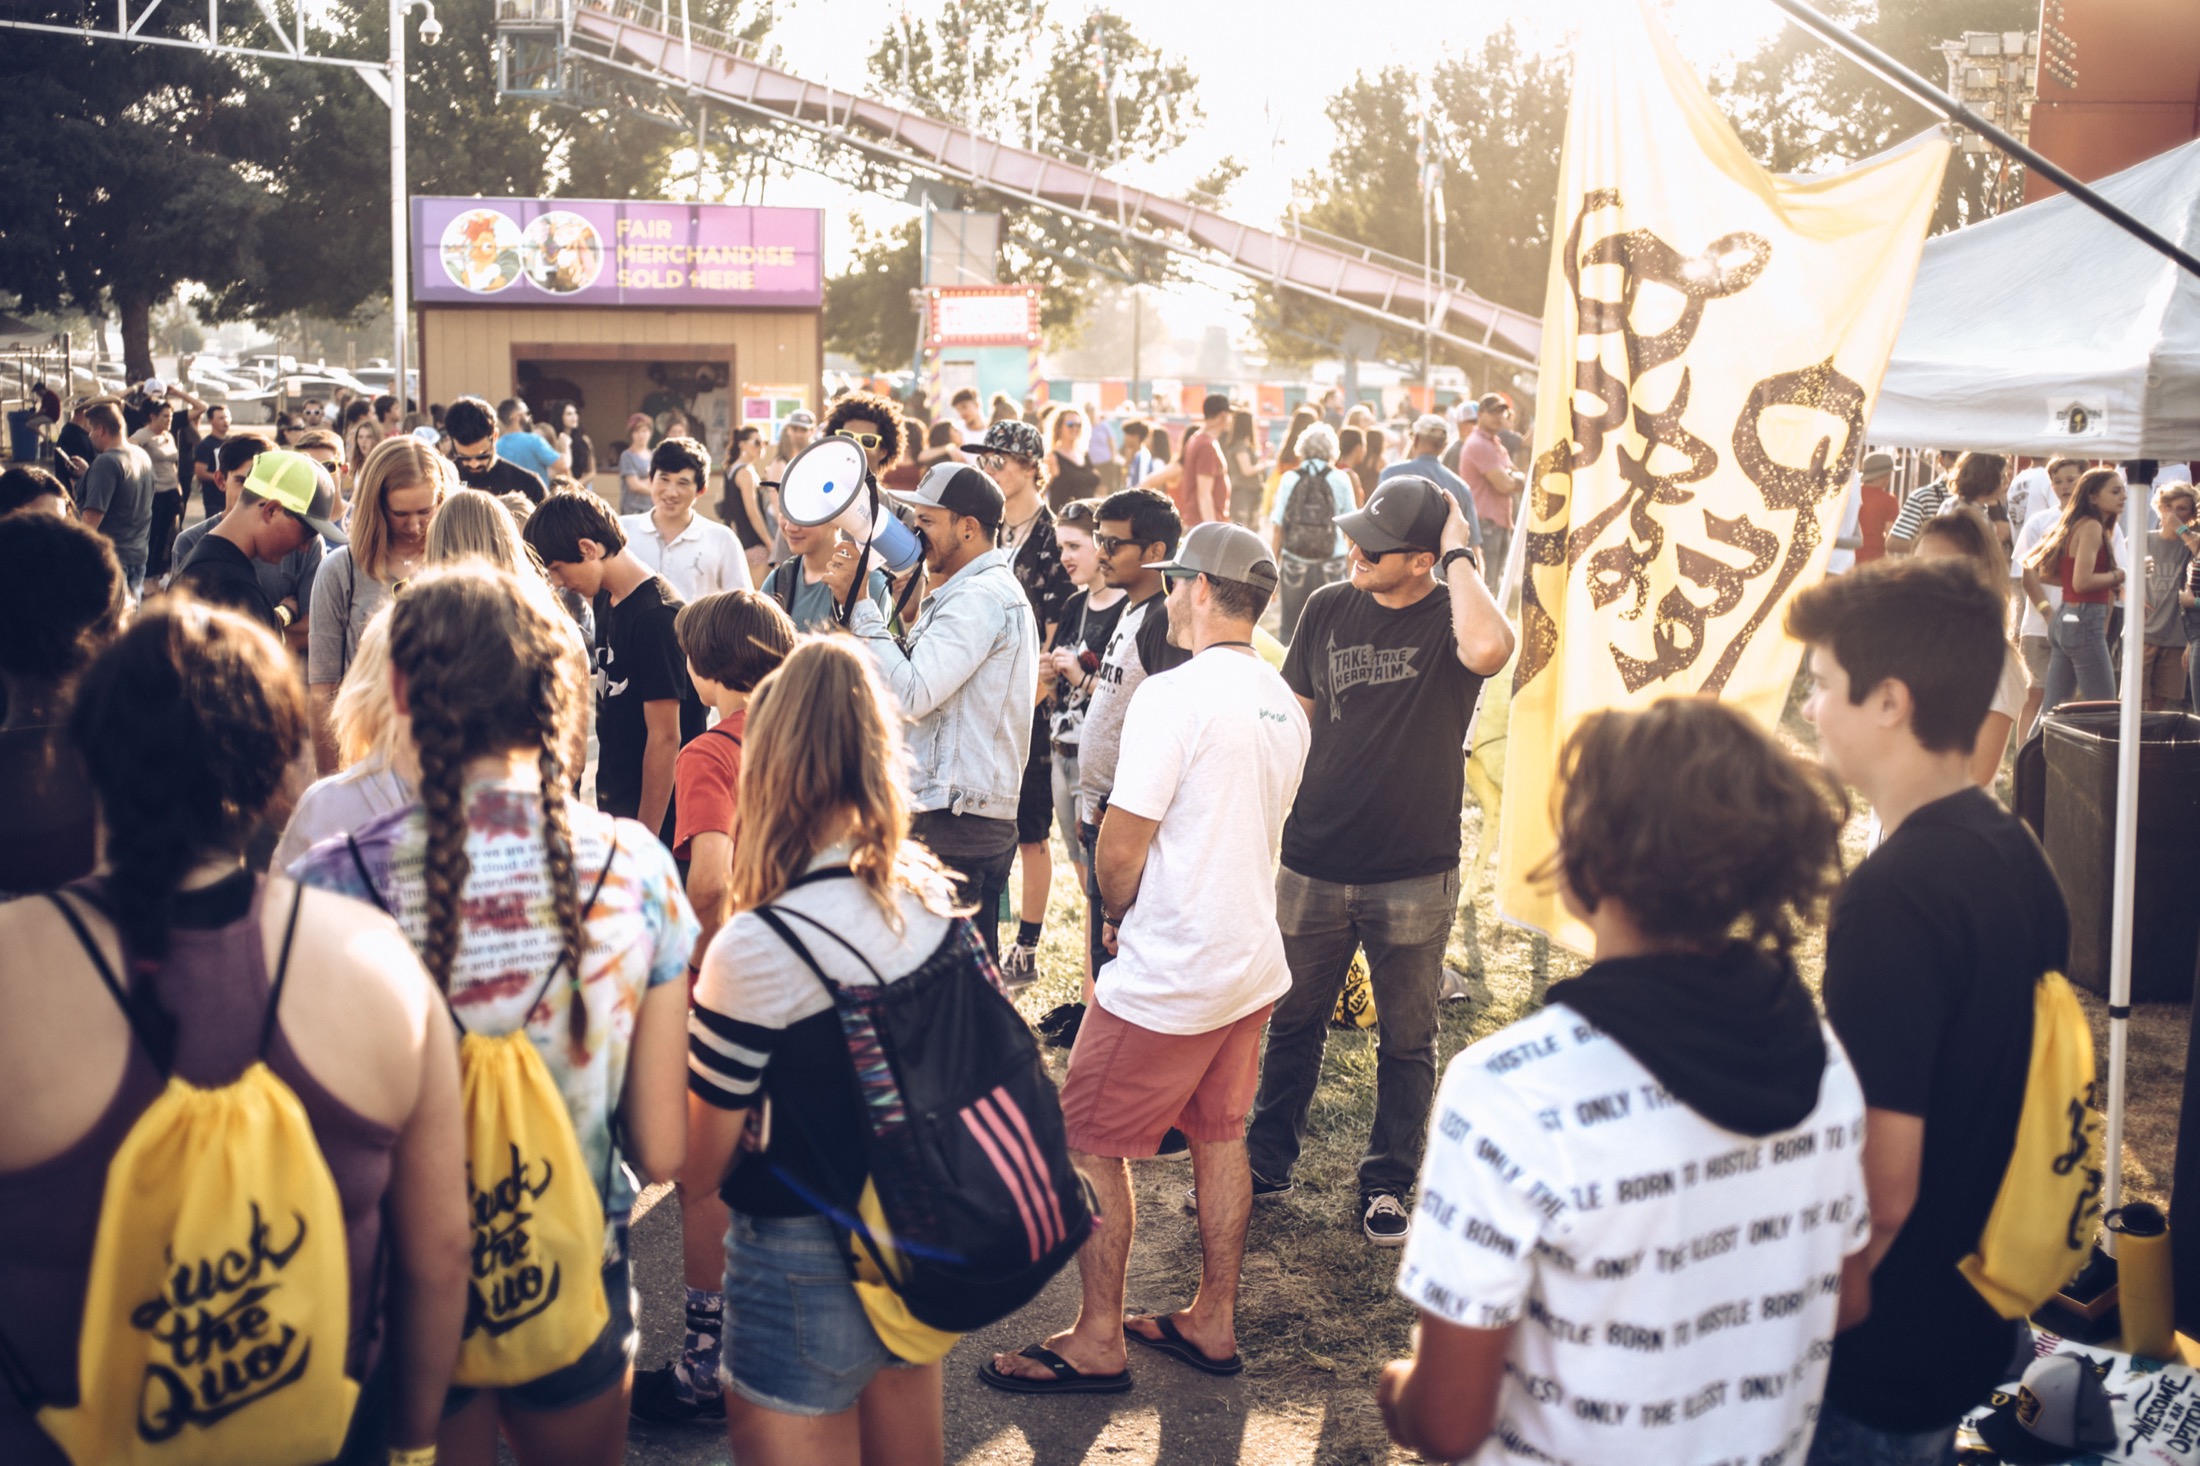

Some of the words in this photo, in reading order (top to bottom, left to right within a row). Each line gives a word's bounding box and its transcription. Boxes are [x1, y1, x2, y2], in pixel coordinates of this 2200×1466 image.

[616, 219, 672, 239] FAIR
[617, 245, 796, 267] MERCHANDISE
[617, 269, 684, 288] SOLD
[689, 270, 755, 289] HERE
[1335, 649, 1368, 673] TAKE
[1375, 650, 1406, 666] TAKE
[1374, 664, 1409, 681] AIM.
[481, 859, 517, 872] cloud
[470, 873, 539, 890] everything
[1576, 1091, 1631, 1128] ONLY
[1617, 1172, 1677, 1203] BORN
[1771, 1130, 1817, 1165] BORN
[1749, 1213, 1794, 1246] ONLY
[1605, 1319, 1666, 1353] BORN
[137, 1323, 312, 1444] Quo
[1574, 1397, 1630, 1426] ONLY
[1640, 1399, 1676, 1428] THE
[1739, 1373, 1788, 1403] ONLY
